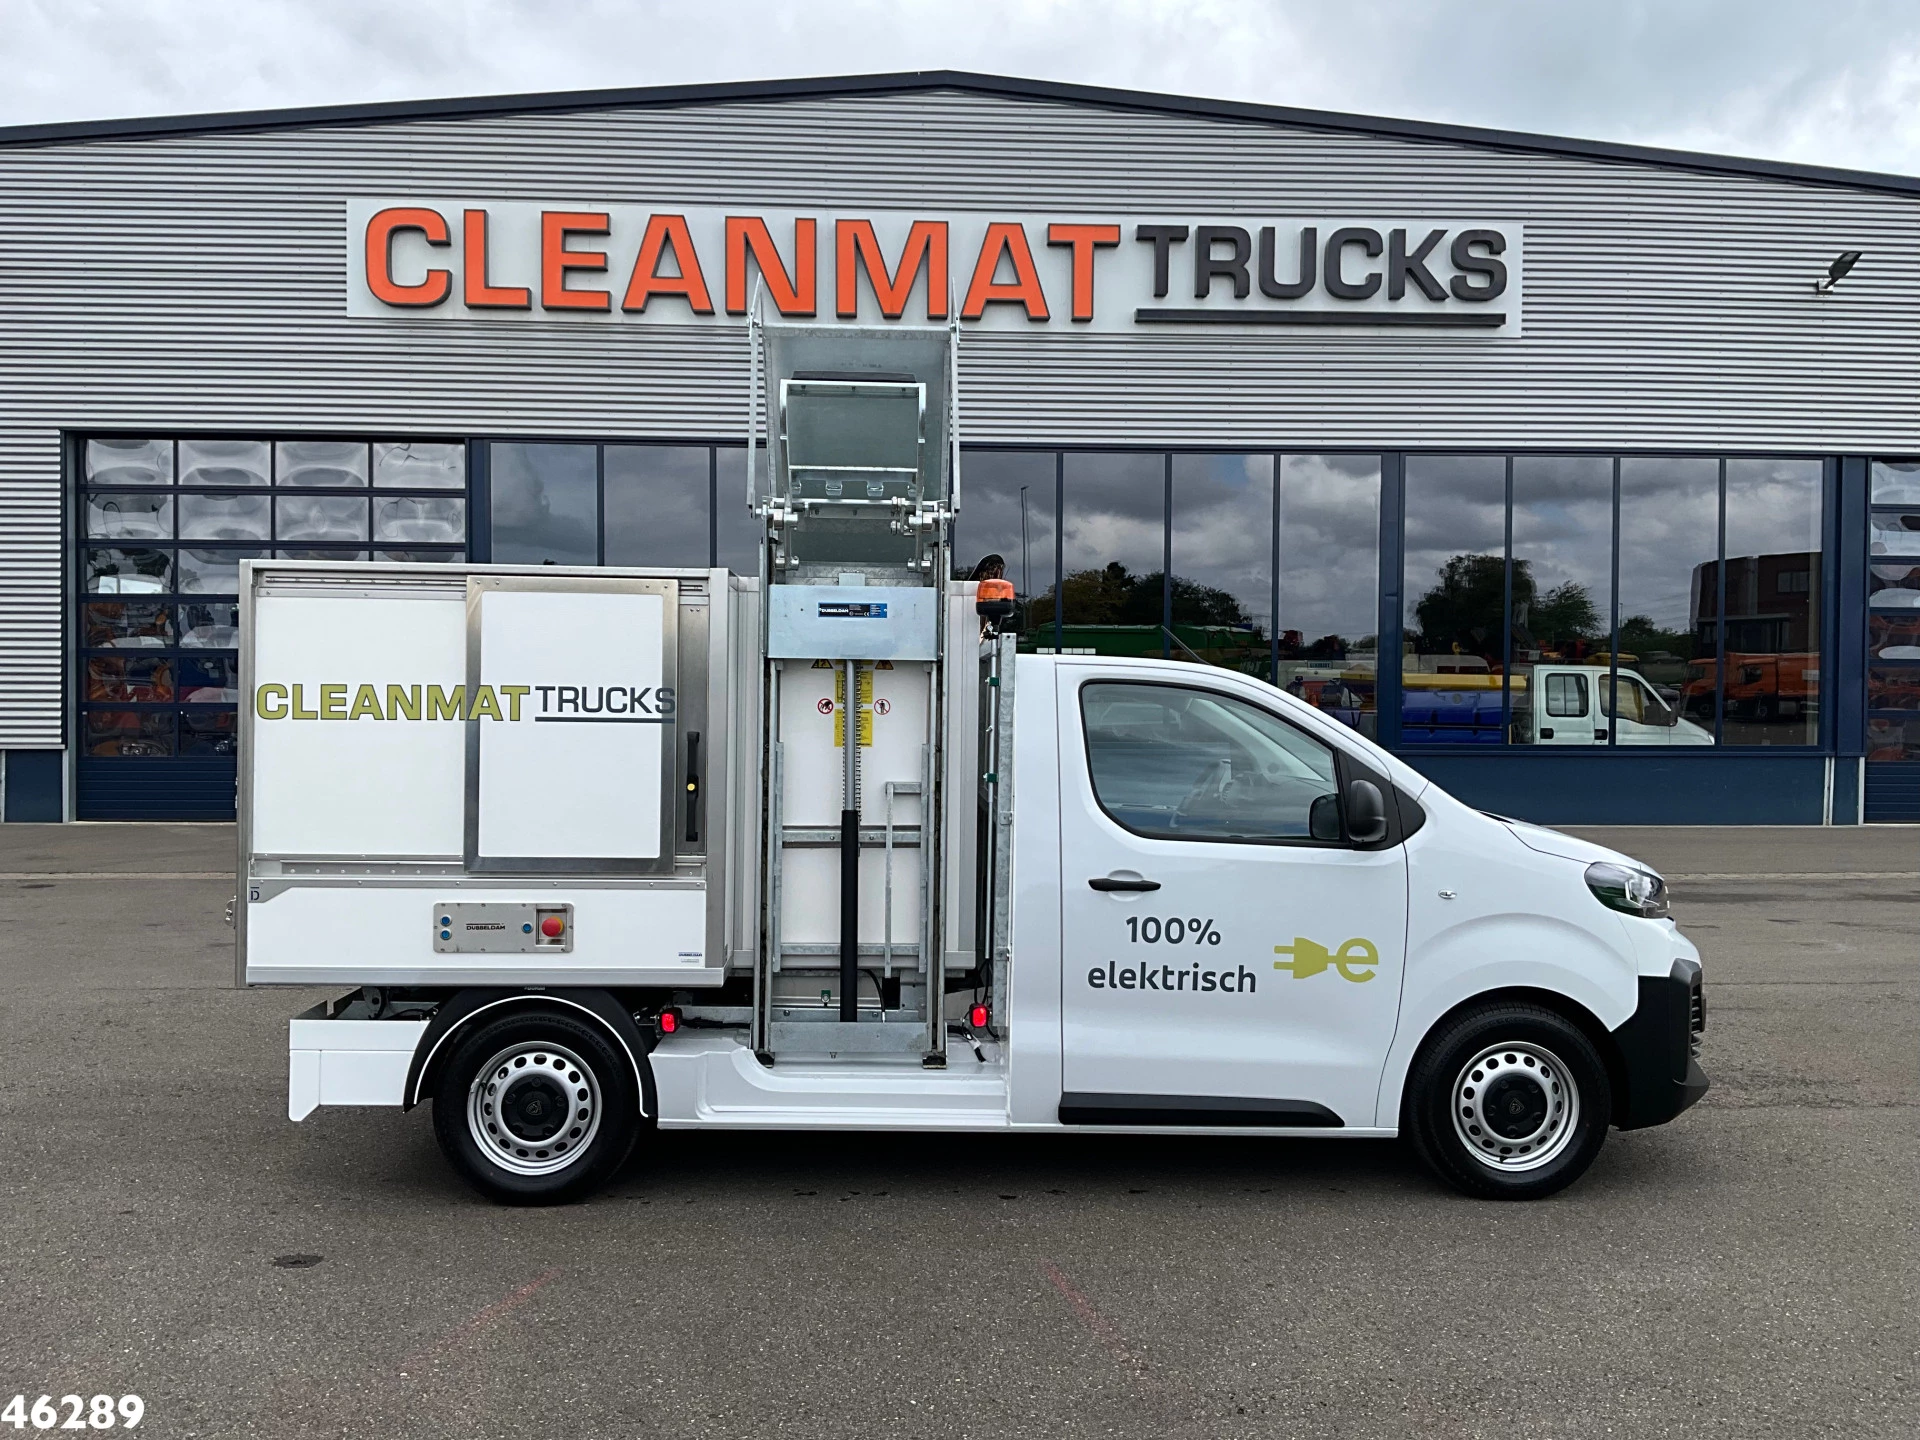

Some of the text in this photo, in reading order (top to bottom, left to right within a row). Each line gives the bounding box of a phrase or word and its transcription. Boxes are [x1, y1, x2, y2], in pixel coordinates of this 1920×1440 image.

[364, 207, 1508, 322] CLEANMAT TRUCKS
[256, 683, 676, 721] CLEANMAT TRUCKS
[1125, 916, 1222, 946] 100%
[1087, 960, 1257, 993] elektrisch
